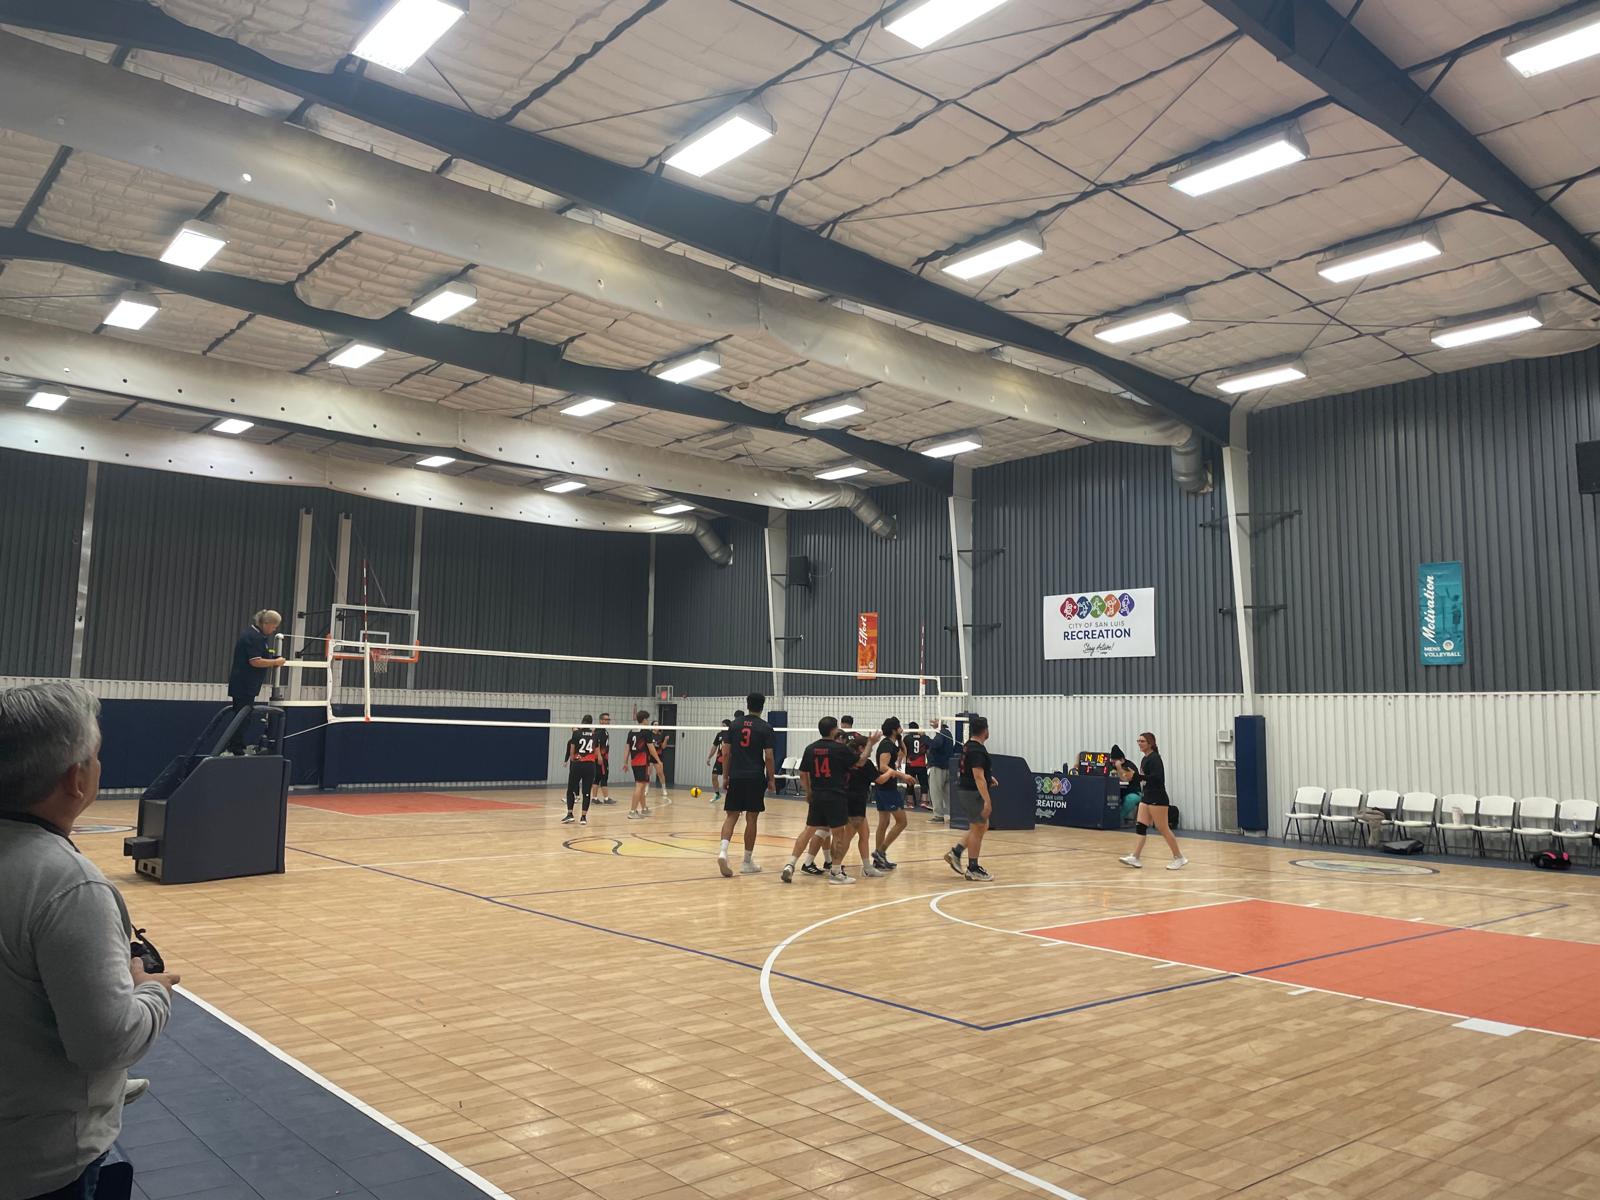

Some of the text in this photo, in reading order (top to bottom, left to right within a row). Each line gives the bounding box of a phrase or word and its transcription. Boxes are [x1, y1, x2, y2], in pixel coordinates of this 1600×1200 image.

[1422, 575, 1437, 644] Motivation
[858, 615, 868, 647] Effort
[1063, 628, 1131, 641] RECREATION
[1083, 642, 1095, 656] Stay
[631, 735, 637, 751] 2
[740, 727, 752, 747] 3
[578, 738, 593, 753] 24
[913, 739, 920, 754] 9
[1084, 753, 1093, 762] 14
[814, 755, 831, 778] 14
